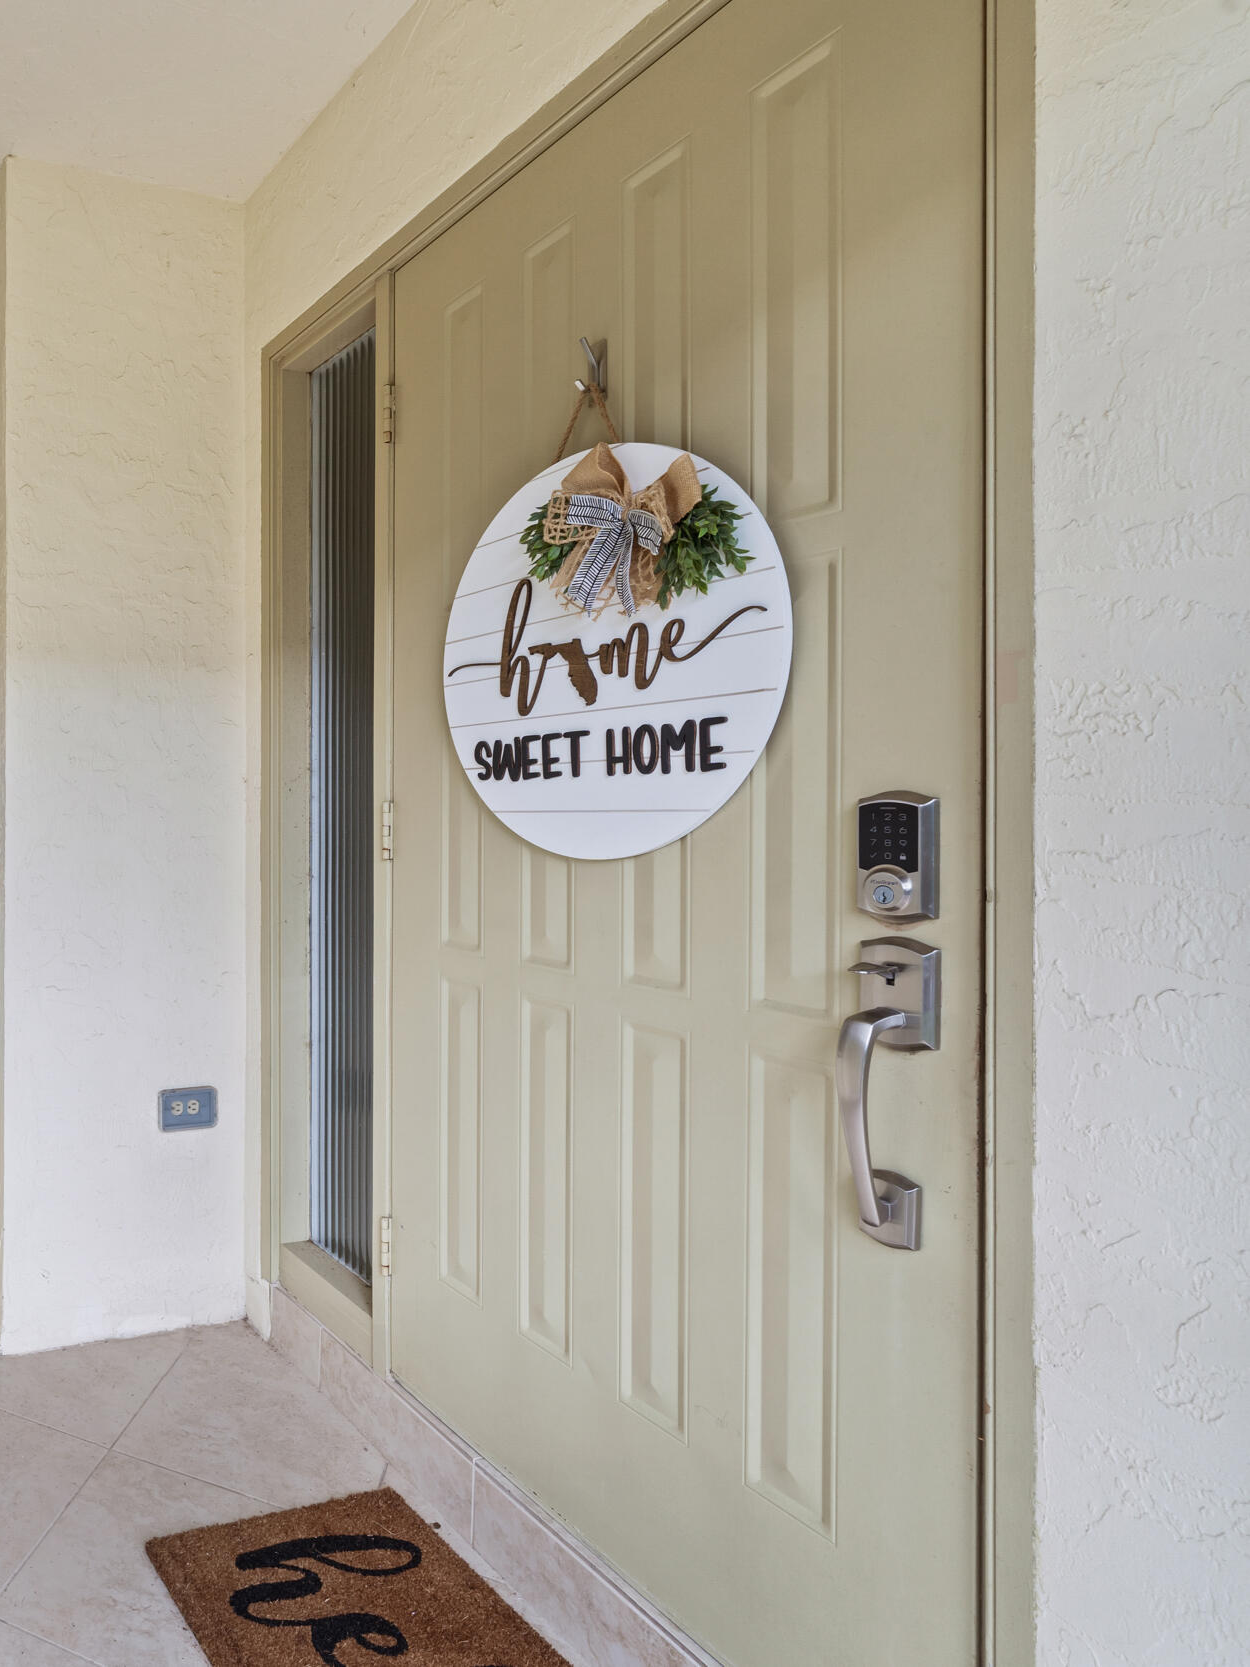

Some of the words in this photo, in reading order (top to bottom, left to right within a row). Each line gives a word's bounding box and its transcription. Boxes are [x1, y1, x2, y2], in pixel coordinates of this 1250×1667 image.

[474, 730, 591, 782] SWEET
[605, 716, 729, 778] HOME
[884, 813, 892, 821] 2
[899, 813, 907, 821] 3
[884, 826, 892, 834] 5
[870, 838, 877, 846] 7
[884, 839, 892, 847] 8
[884, 852, 892, 860] 0
